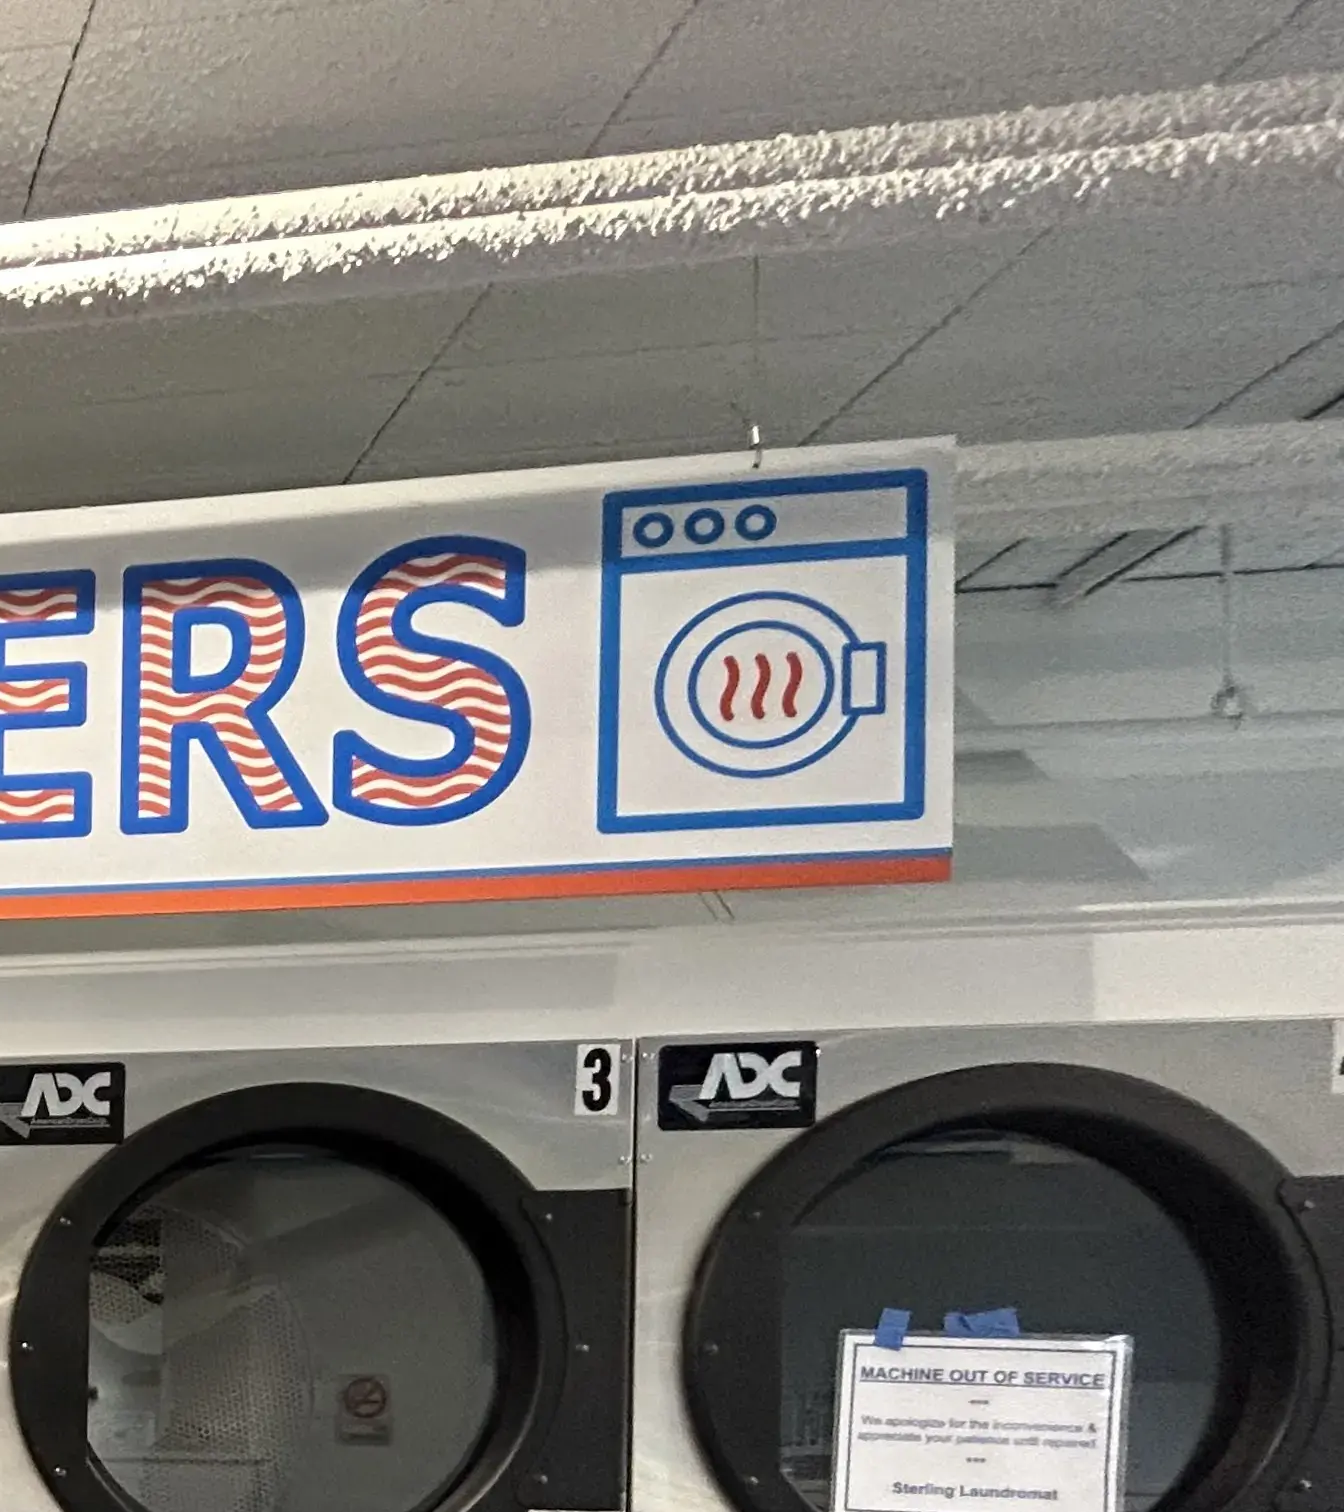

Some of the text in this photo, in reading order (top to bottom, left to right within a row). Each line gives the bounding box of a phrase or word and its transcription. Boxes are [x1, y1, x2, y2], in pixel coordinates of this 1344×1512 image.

[20, 1071, 112, 1117] ADC
[581, 1047, 613, 1113] 3
[699, 1050, 803, 1100] ADC
[859, 1365, 1106, 1387] MACHINE OUT OF SERVICE
[892, 1481, 1059, 1501] Sterling Laundromat
